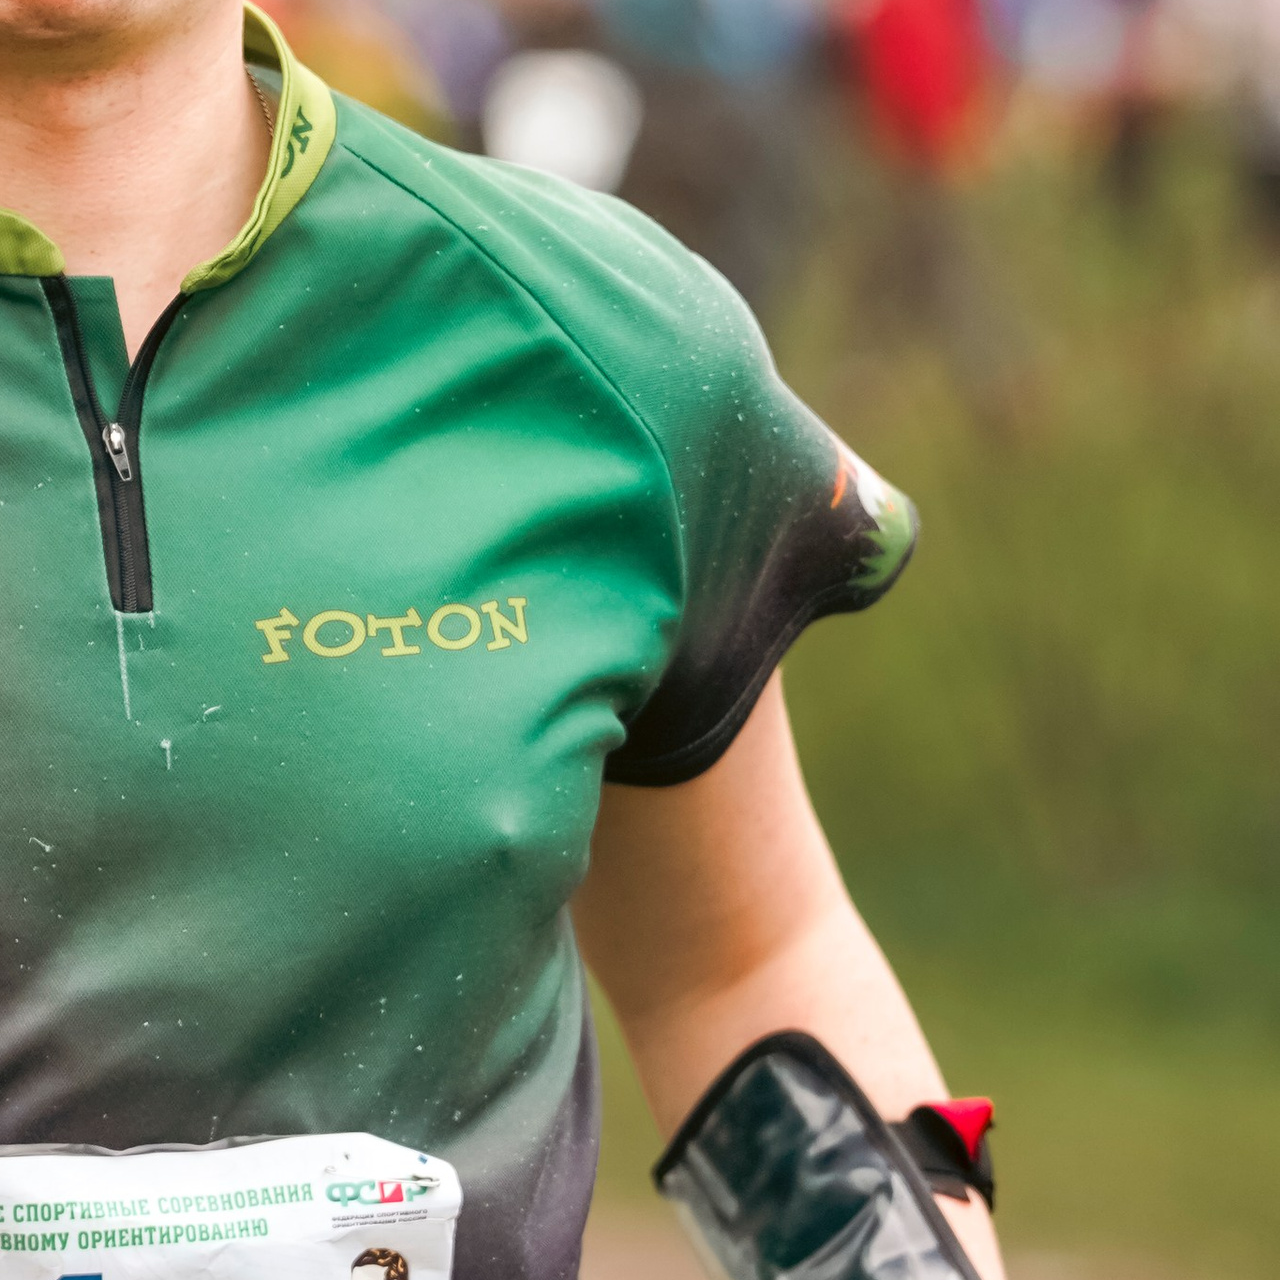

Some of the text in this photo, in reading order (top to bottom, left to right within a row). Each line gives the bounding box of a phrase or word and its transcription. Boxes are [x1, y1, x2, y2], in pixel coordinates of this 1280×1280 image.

[254, 597, 529, 664] FOTON
[13, 1199, 151, 1222] СПОРТИВНЫЕ
[157, 1183, 314, 1214] СОРЕВНОВАНИЯ
[78, 1218, 269, 1251] ОРИЕНТИРОВАНИЮ
